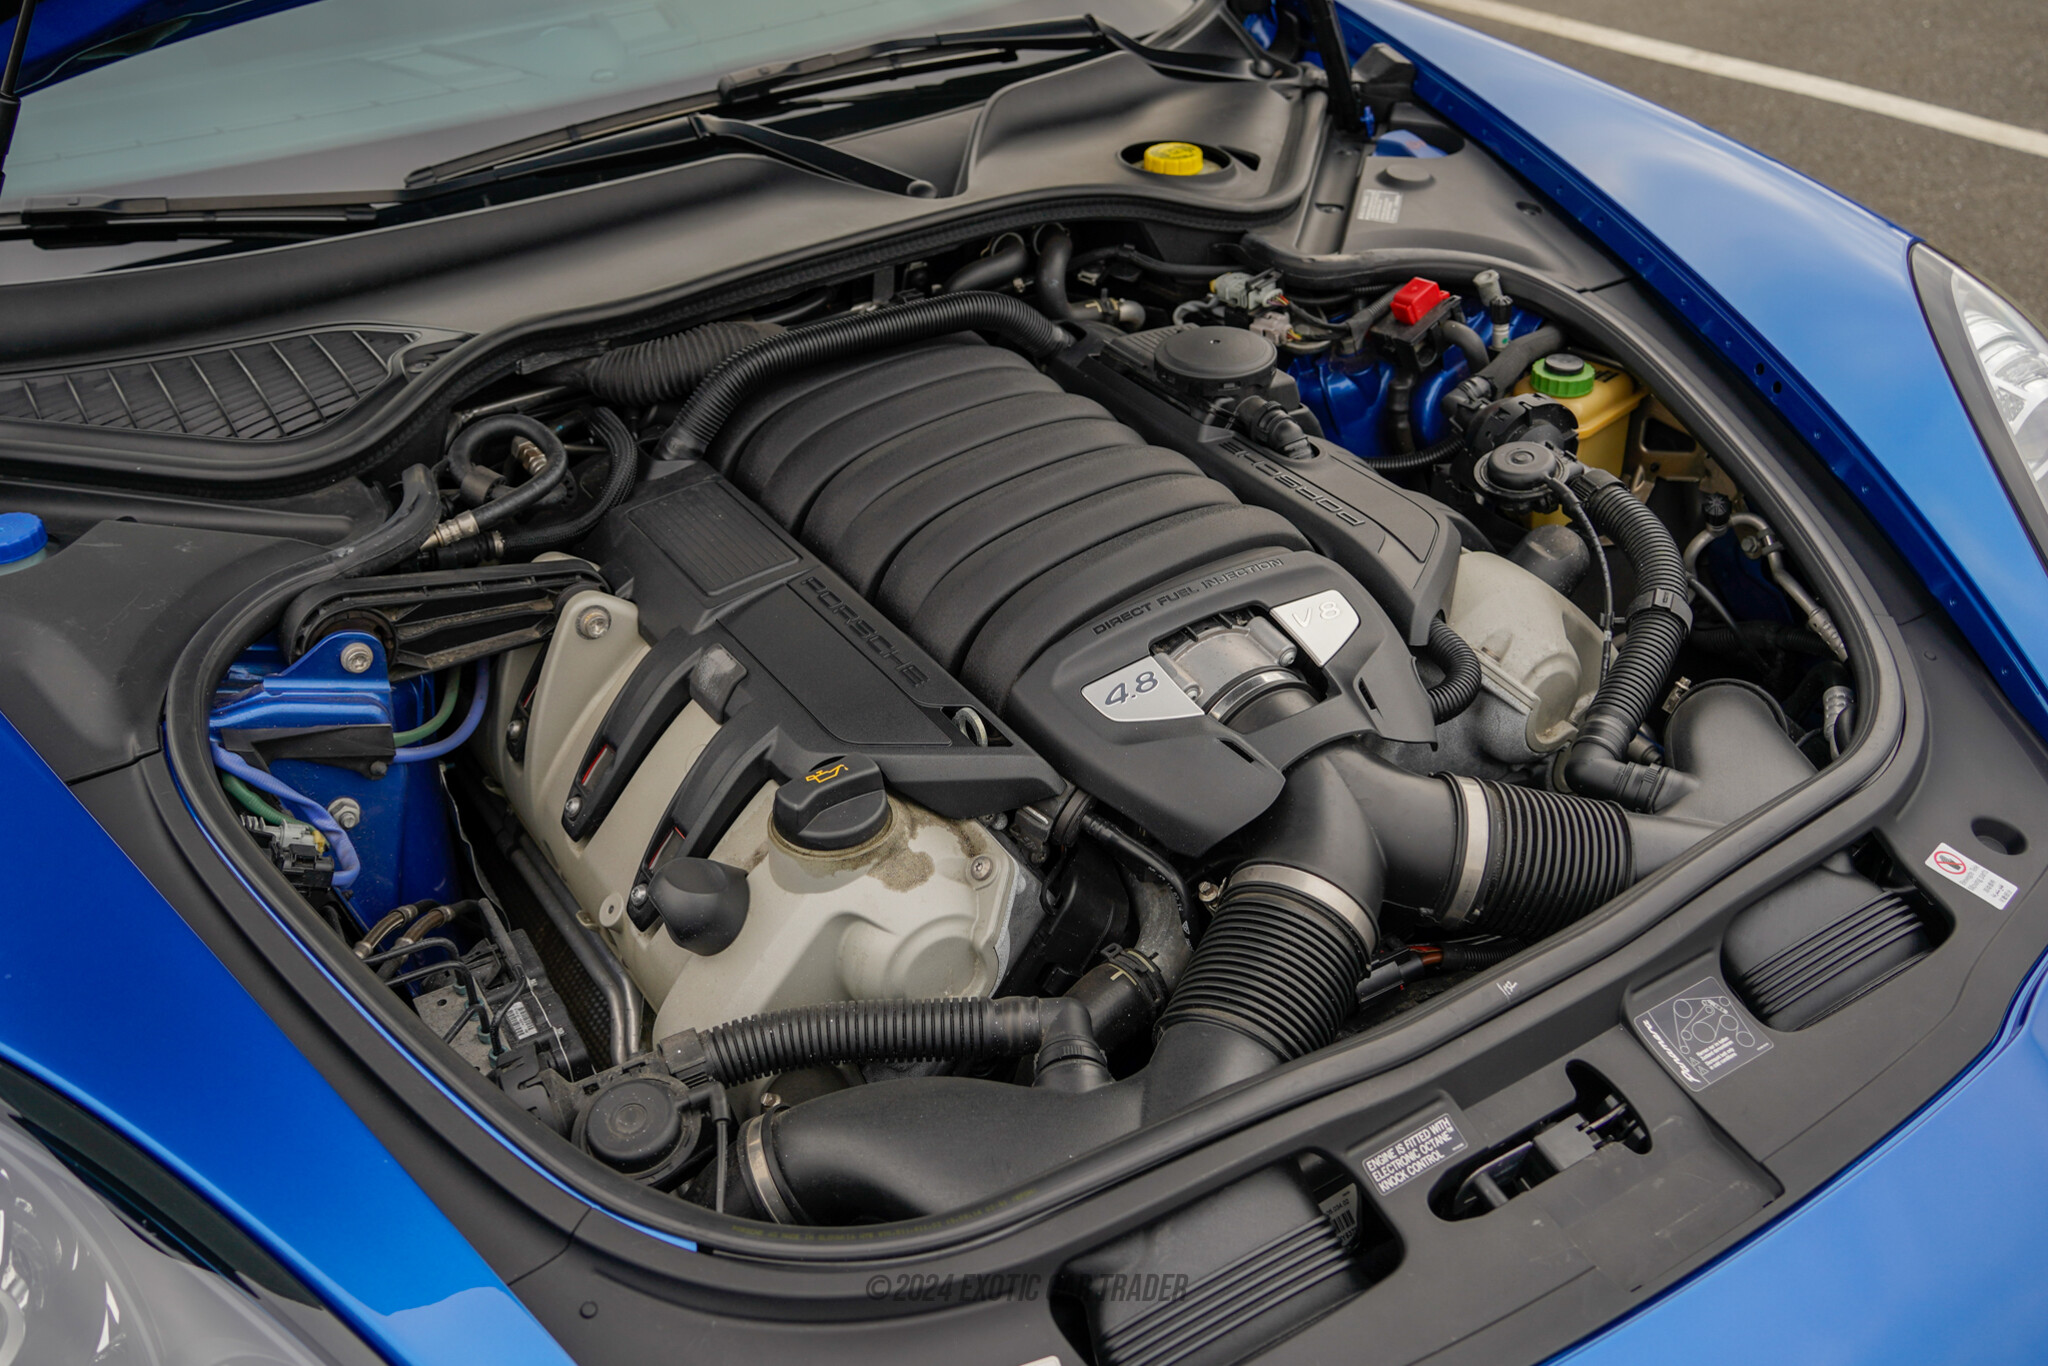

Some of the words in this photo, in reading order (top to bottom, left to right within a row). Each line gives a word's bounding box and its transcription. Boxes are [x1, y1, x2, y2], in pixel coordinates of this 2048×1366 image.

[1218, 441, 1365, 526] PORSCHE
[1092, 602, 1151, 635] DIRECT
[1157, 586, 1200, 606] FUEL
[1200, 558, 1284, 589] INJECTION
[801, 576, 931, 688] PORSCHE
[1104, 671, 1158, 705] 4.8
[1643, 1019, 1701, 1083] Panamera
[1366, 1148, 1397, 1172] ENGINE
[1395, 1143, 1406, 1155] IS
[1403, 1129, 1431, 1150] FITTED
[1429, 1117, 1451, 1135] WITH
[1371, 1148, 1421, 1182] ELECTRONIC
[1378, 1169, 1409, 1192] KNOCK
[1407, 1150, 1445, 1176] CONTROL
